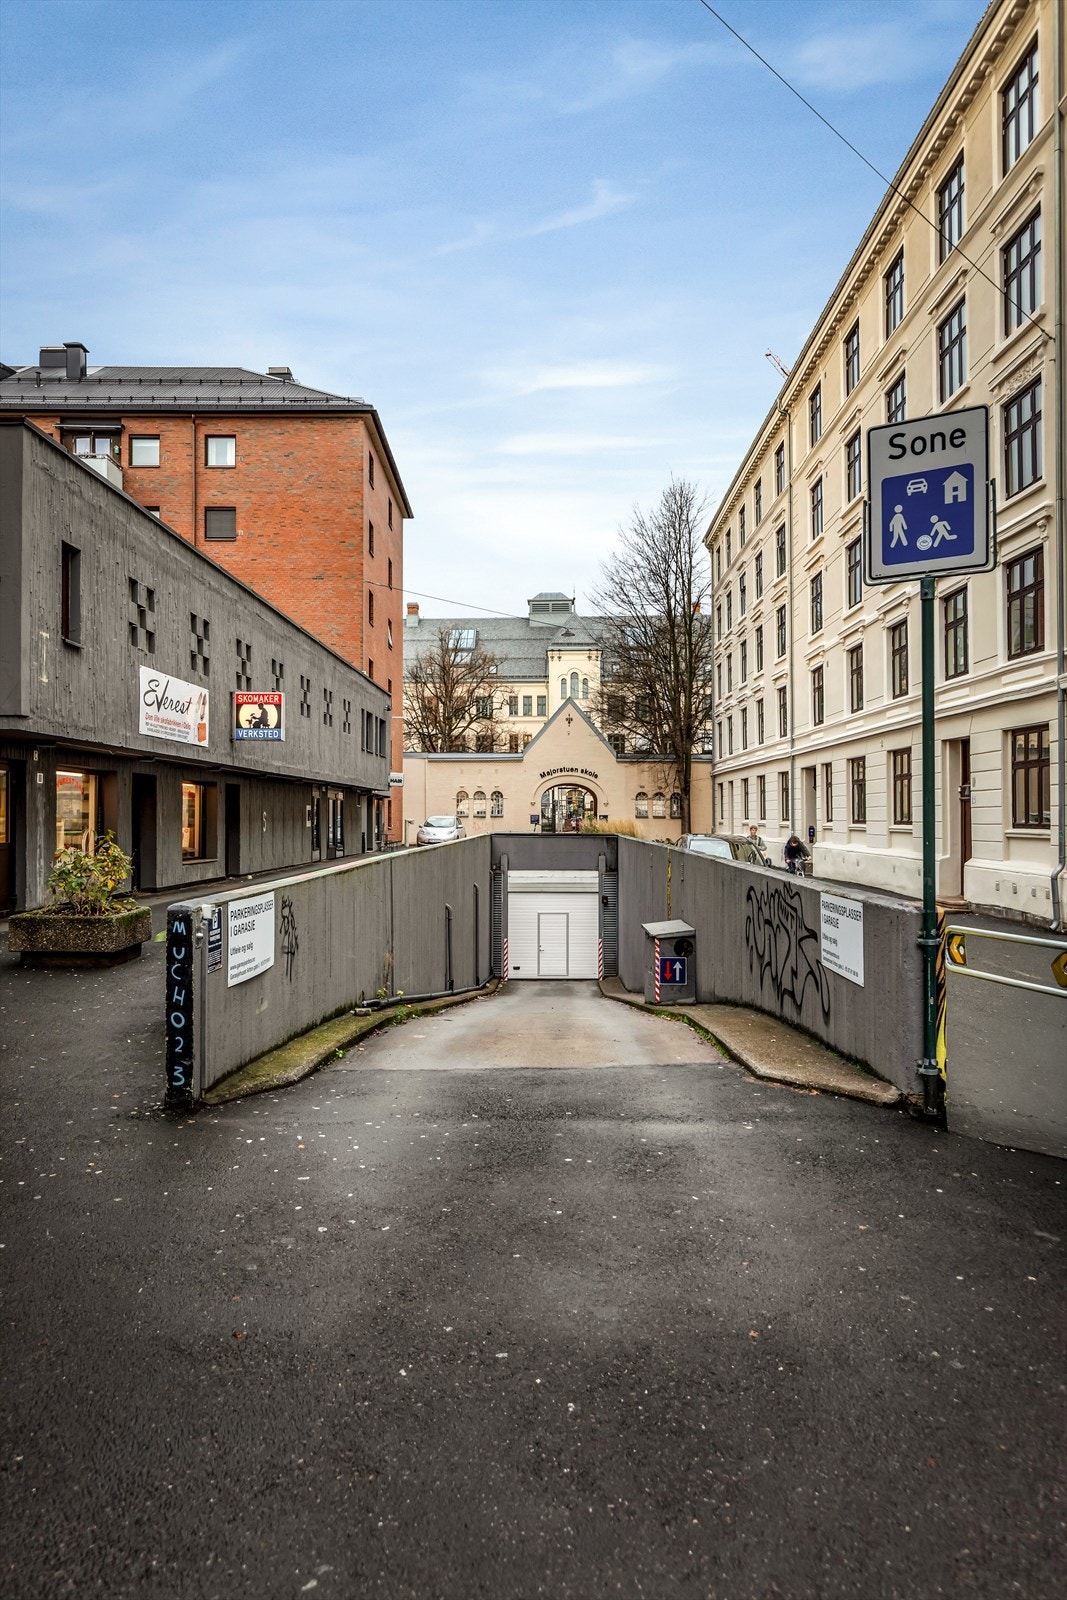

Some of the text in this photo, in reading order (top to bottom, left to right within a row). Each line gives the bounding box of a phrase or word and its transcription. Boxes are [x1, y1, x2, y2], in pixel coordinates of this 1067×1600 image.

[888, 428, 967, 460] Sone
[143, 679, 192, 714] Everest
[237, 694, 279, 703] SKOMAKER
[238, 729, 279, 738] VERKSTED
[539, 766, 599, 779] Majorstuen skole
[231, 899, 273, 921] PARKERINGSPLASSER
[822, 900, 861, 921] PARKERINGSPLASSER
[234, 920, 255, 936] GARASJE
[824, 914, 839, 928] GARASJE
